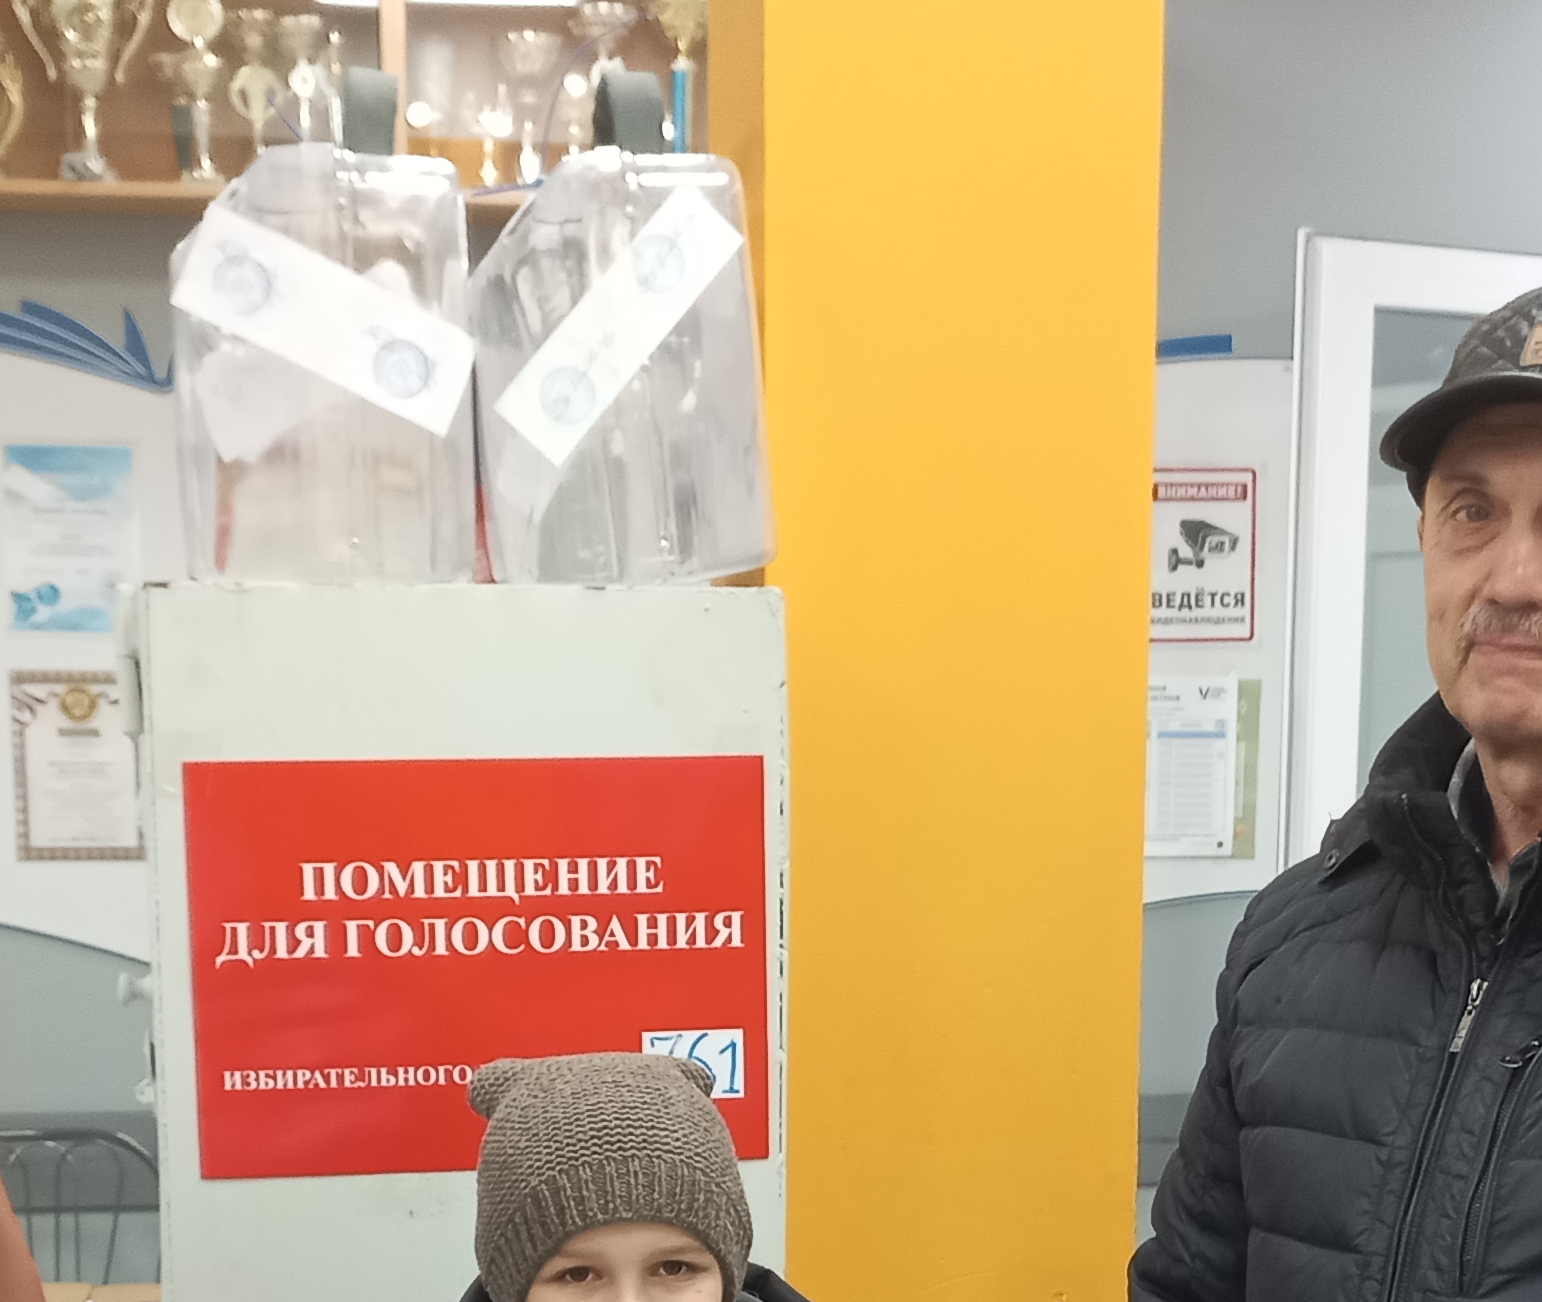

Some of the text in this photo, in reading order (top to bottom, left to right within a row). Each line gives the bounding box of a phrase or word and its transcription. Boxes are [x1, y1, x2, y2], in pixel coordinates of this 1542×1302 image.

[1152, 586, 1245, 612] ВЕДЁТСЯ
[300, 857, 663, 903] ПОМЕЩЕНИЕ
[215, 911, 745, 968] ДЛЯ ГОЛОСОВАНИЯ
[223, 1064, 470, 1092] ИЗБИРАТЕЛЬНОГО
